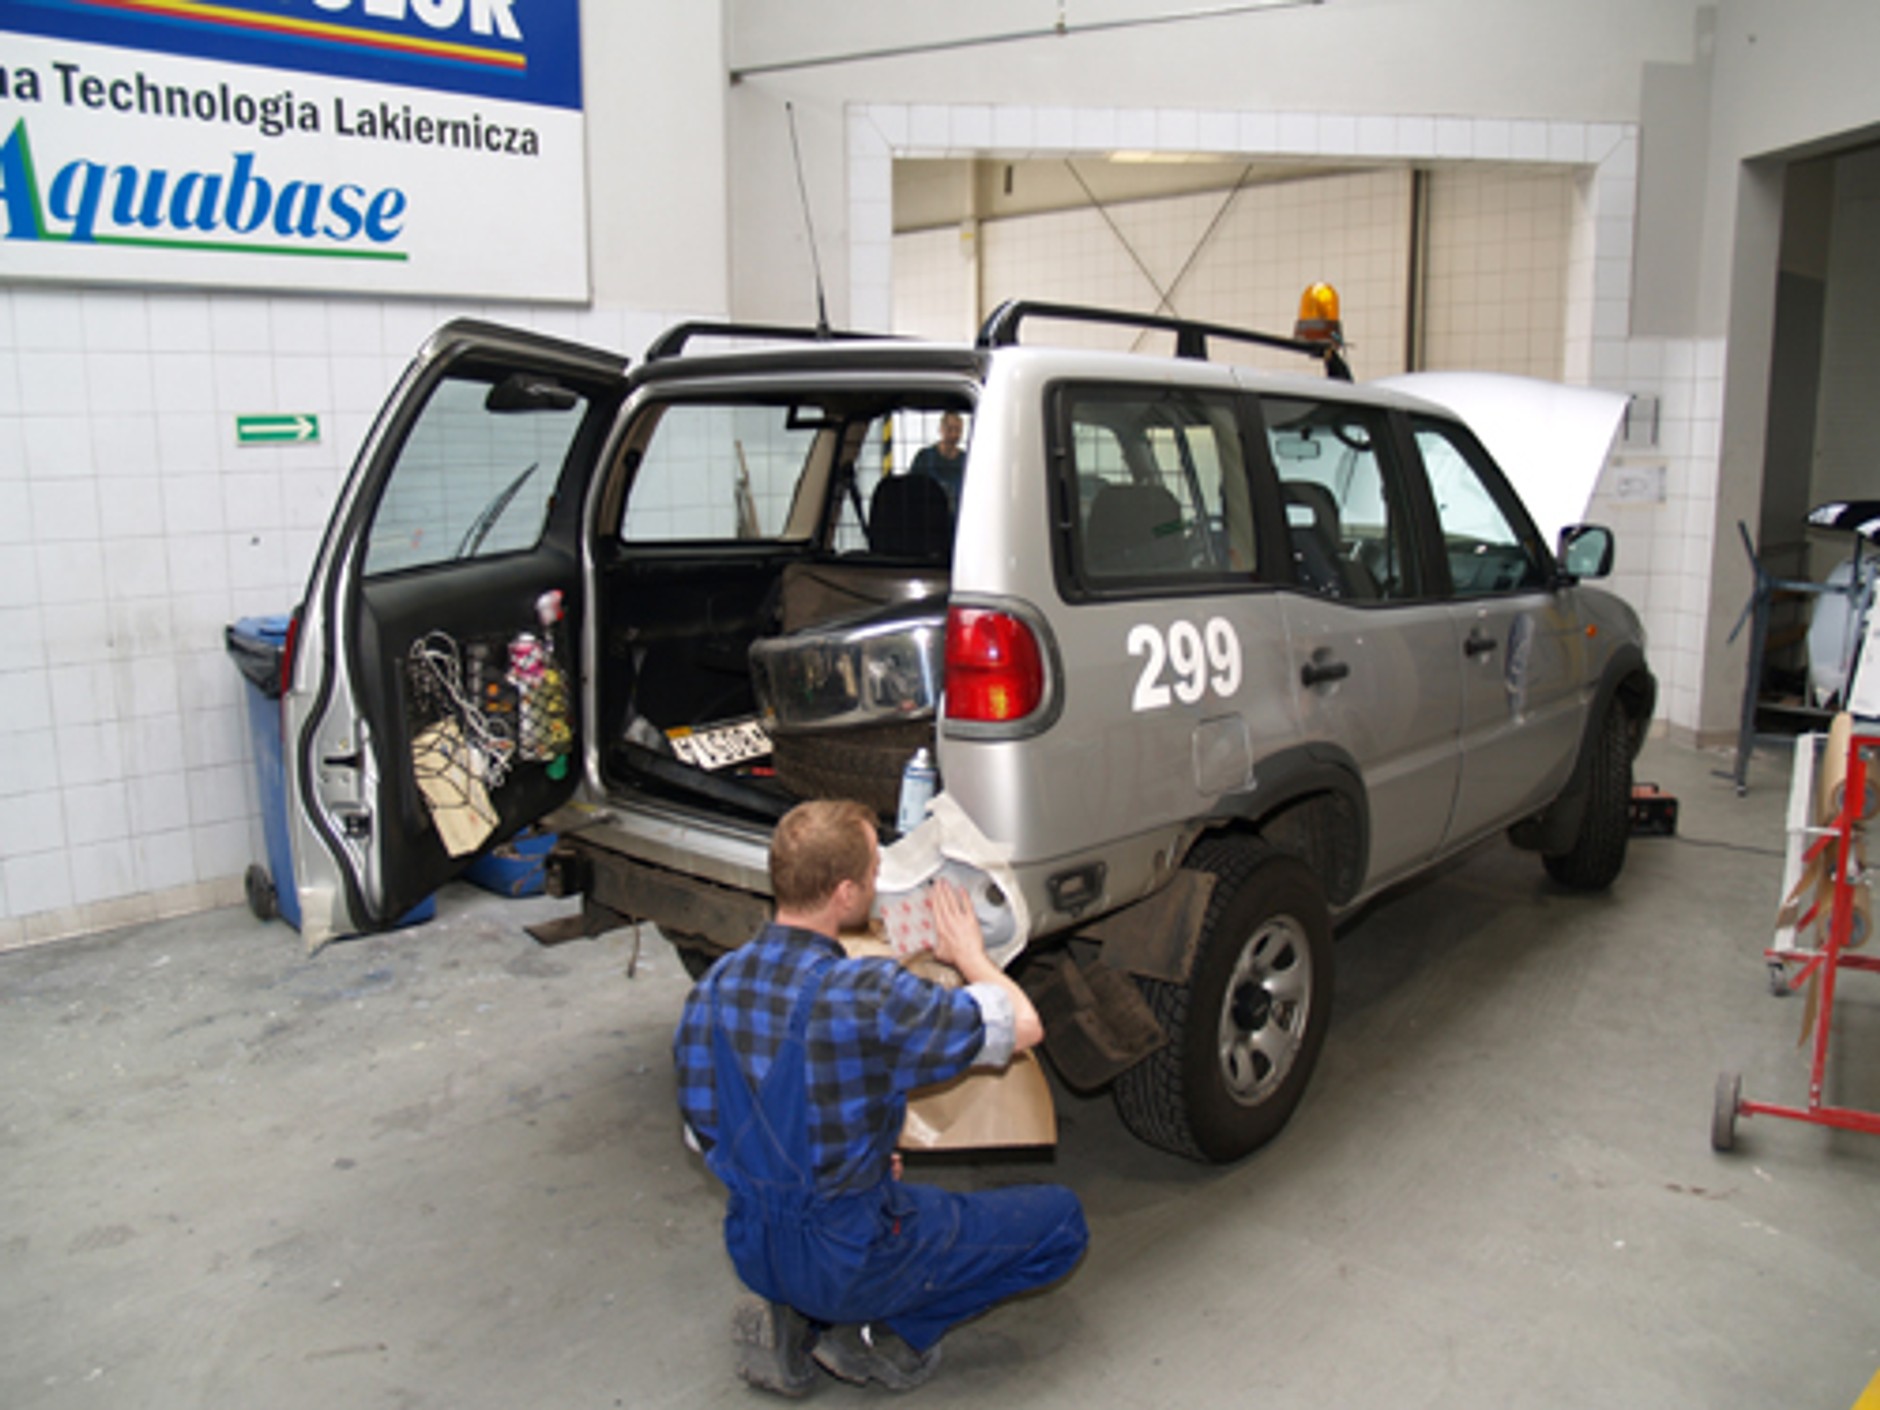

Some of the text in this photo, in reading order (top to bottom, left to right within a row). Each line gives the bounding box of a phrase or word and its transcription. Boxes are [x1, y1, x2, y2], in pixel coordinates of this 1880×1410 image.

[52, 61, 320, 137] Technologia
[334, 97, 539, 156] Lakiernicza
[0, 117, 406, 244] Aquabase
[1127, 616, 1242, 712] 299
